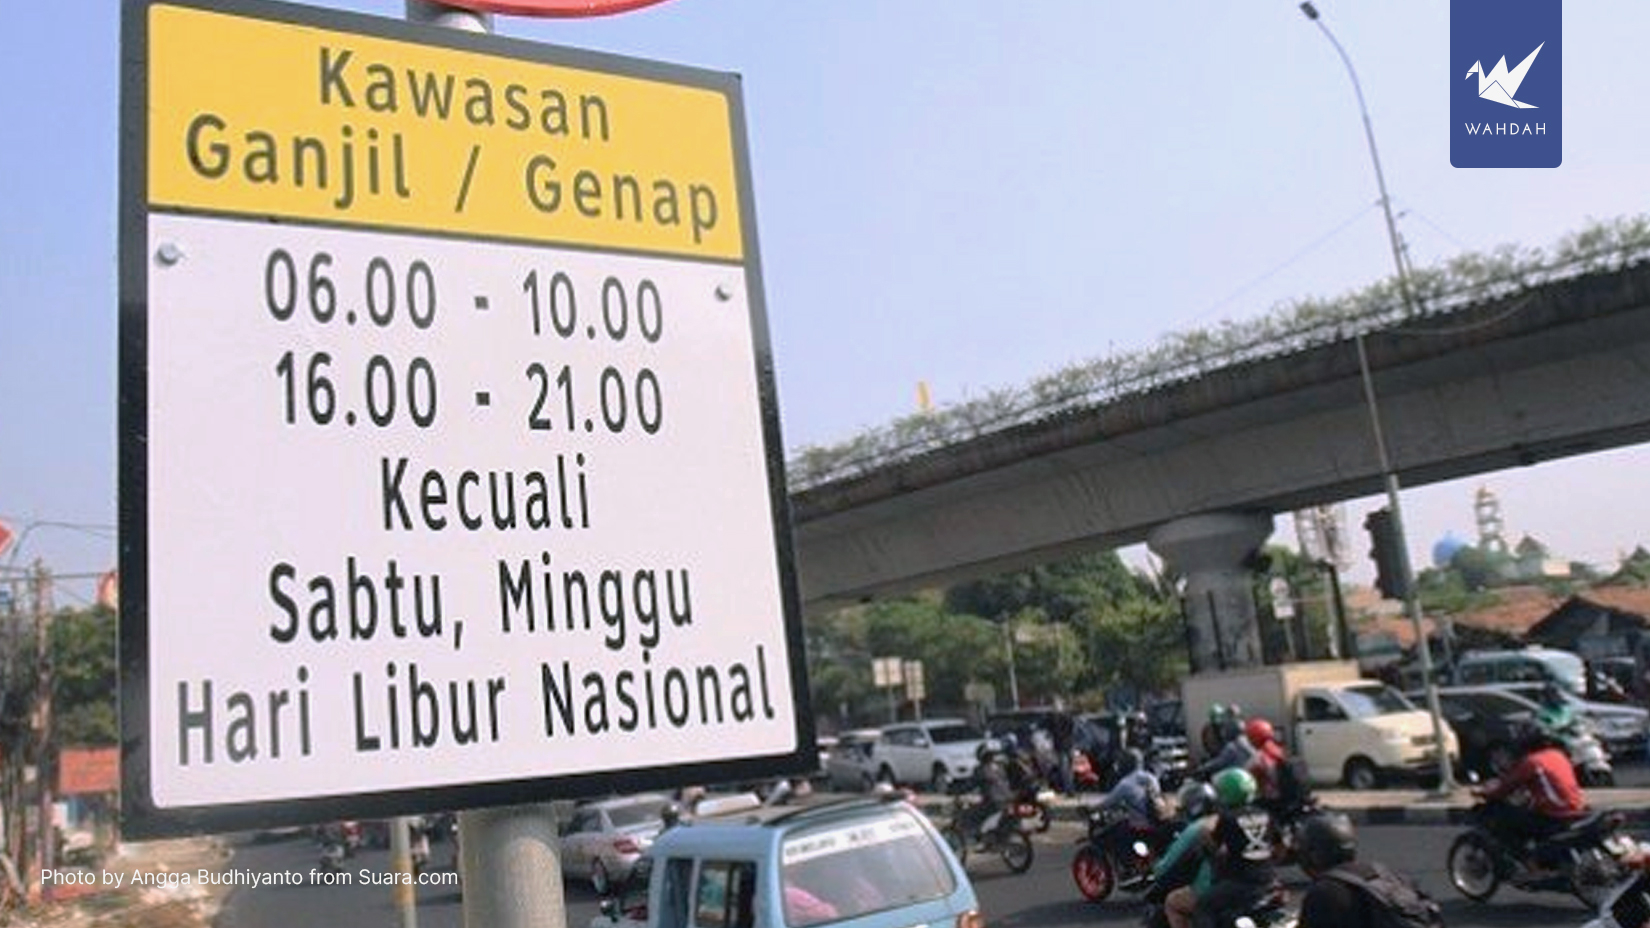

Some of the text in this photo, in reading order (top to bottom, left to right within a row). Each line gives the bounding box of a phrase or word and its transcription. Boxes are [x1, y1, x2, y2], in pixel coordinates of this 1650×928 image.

[318, 46, 611, 142] Kawasan
[186, 114, 719, 243] Ganjil / Genap
[264, 248, 664, 344] 06.00 - 10.00
[276, 350, 664, 436] 16.00 - 21.00
[381, 454, 591, 532] Kecuali
[269, 553, 694, 650] Sabtu, Minggu
[177, 645, 776, 766] Hari Libur Nasional
